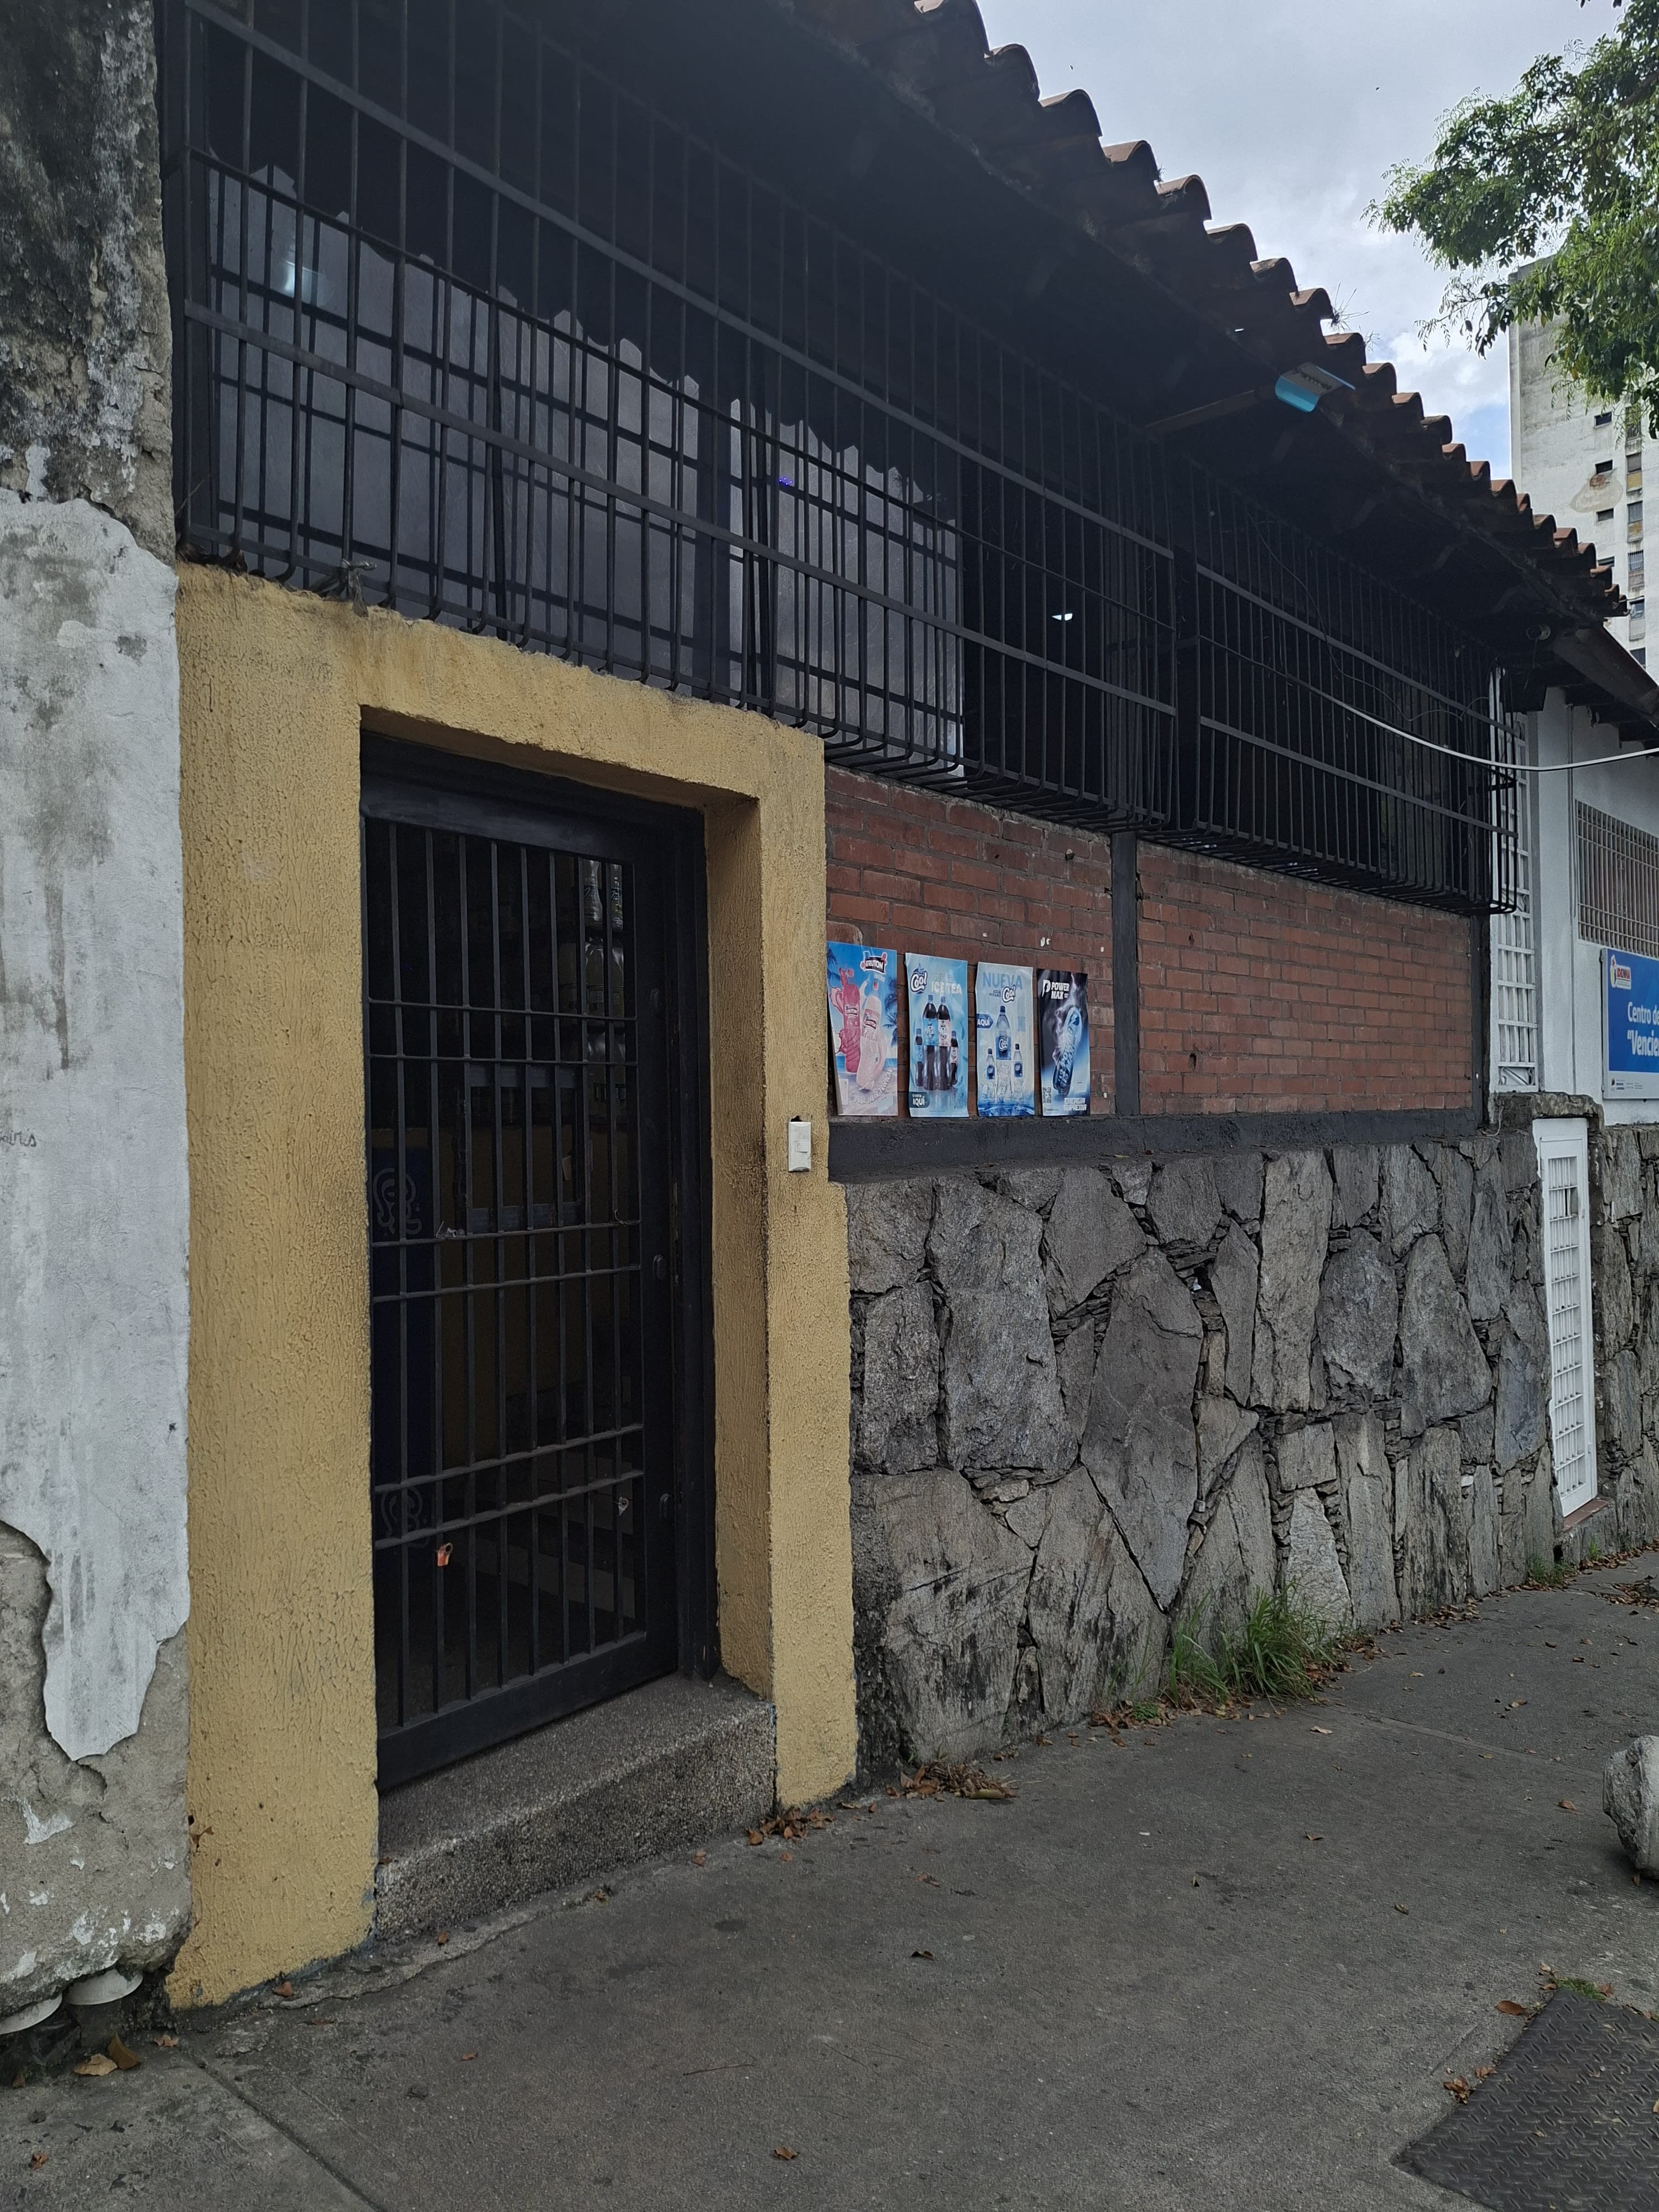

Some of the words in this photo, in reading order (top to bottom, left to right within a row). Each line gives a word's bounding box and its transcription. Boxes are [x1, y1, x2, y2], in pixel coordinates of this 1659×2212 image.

[866, 959, 884, 970] FRUTON
[910, 971, 927, 992] Cool
[931, 981, 945, 994] ICE
[946, 983, 962, 995] TEA
[982, 972, 1022, 990] NUEVA
[1051, 982, 1070, 992] POWER
[1003, 984, 1015, 1003] Cool
[1051, 991, 1064, 1000] MAX
[1627, 1001, 1651, 1024] Centro
[977, 1018, 990, 1027] AQUÍ
[1627, 1030, 1659, 1057] "Vencie
[912, 1096, 925, 1107] AQUÍ
